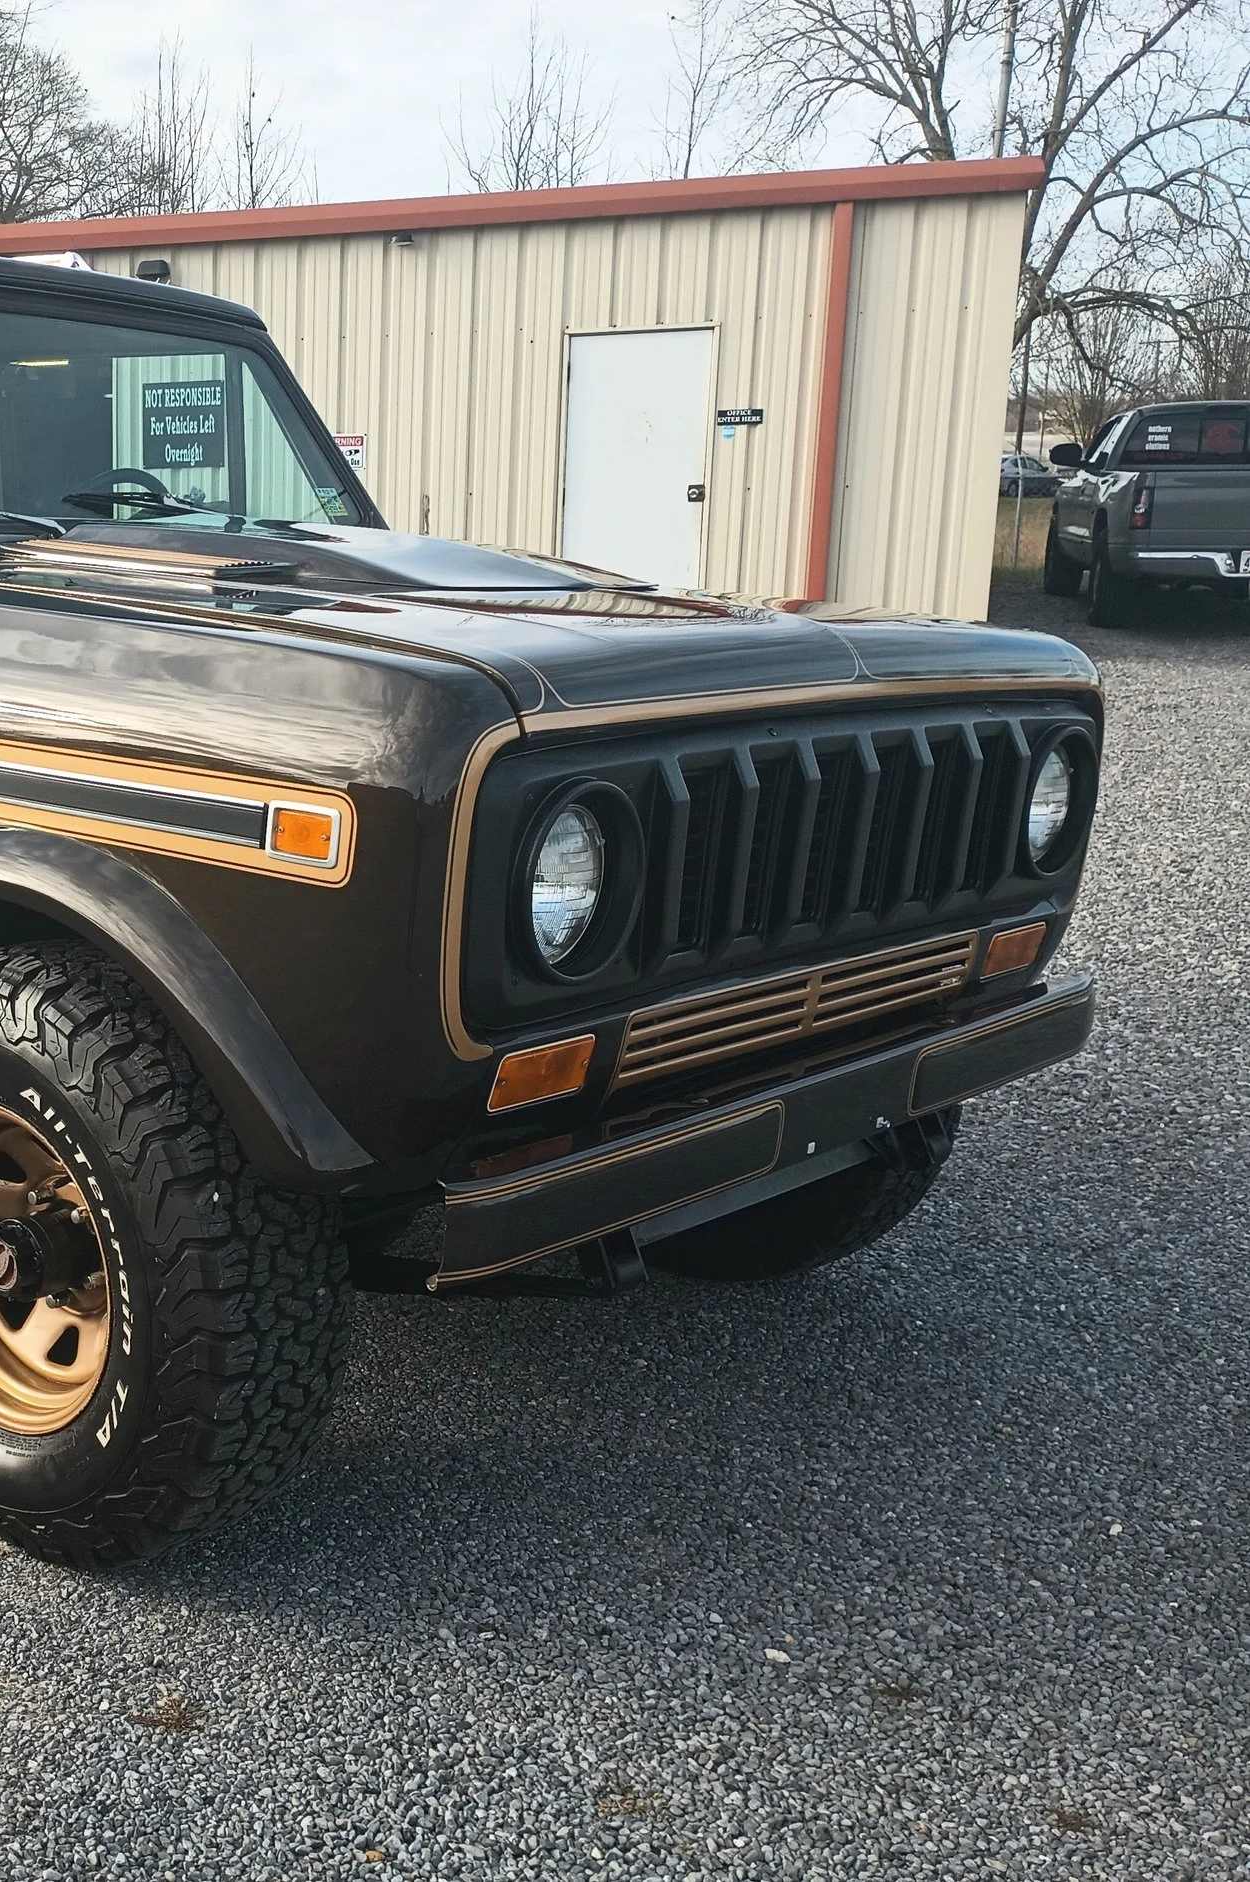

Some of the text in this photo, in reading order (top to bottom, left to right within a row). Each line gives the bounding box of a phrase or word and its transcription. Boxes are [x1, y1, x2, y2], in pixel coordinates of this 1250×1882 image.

[145, 386, 222, 408] NOT RESPONSIBLE
[150, 414, 215, 435] For Vehicles Left
[334, 437, 362, 446] RNING
[165, 442, 204, 467] Overnight
[19, 1087, 134, 1448] All-Terrain T/A
